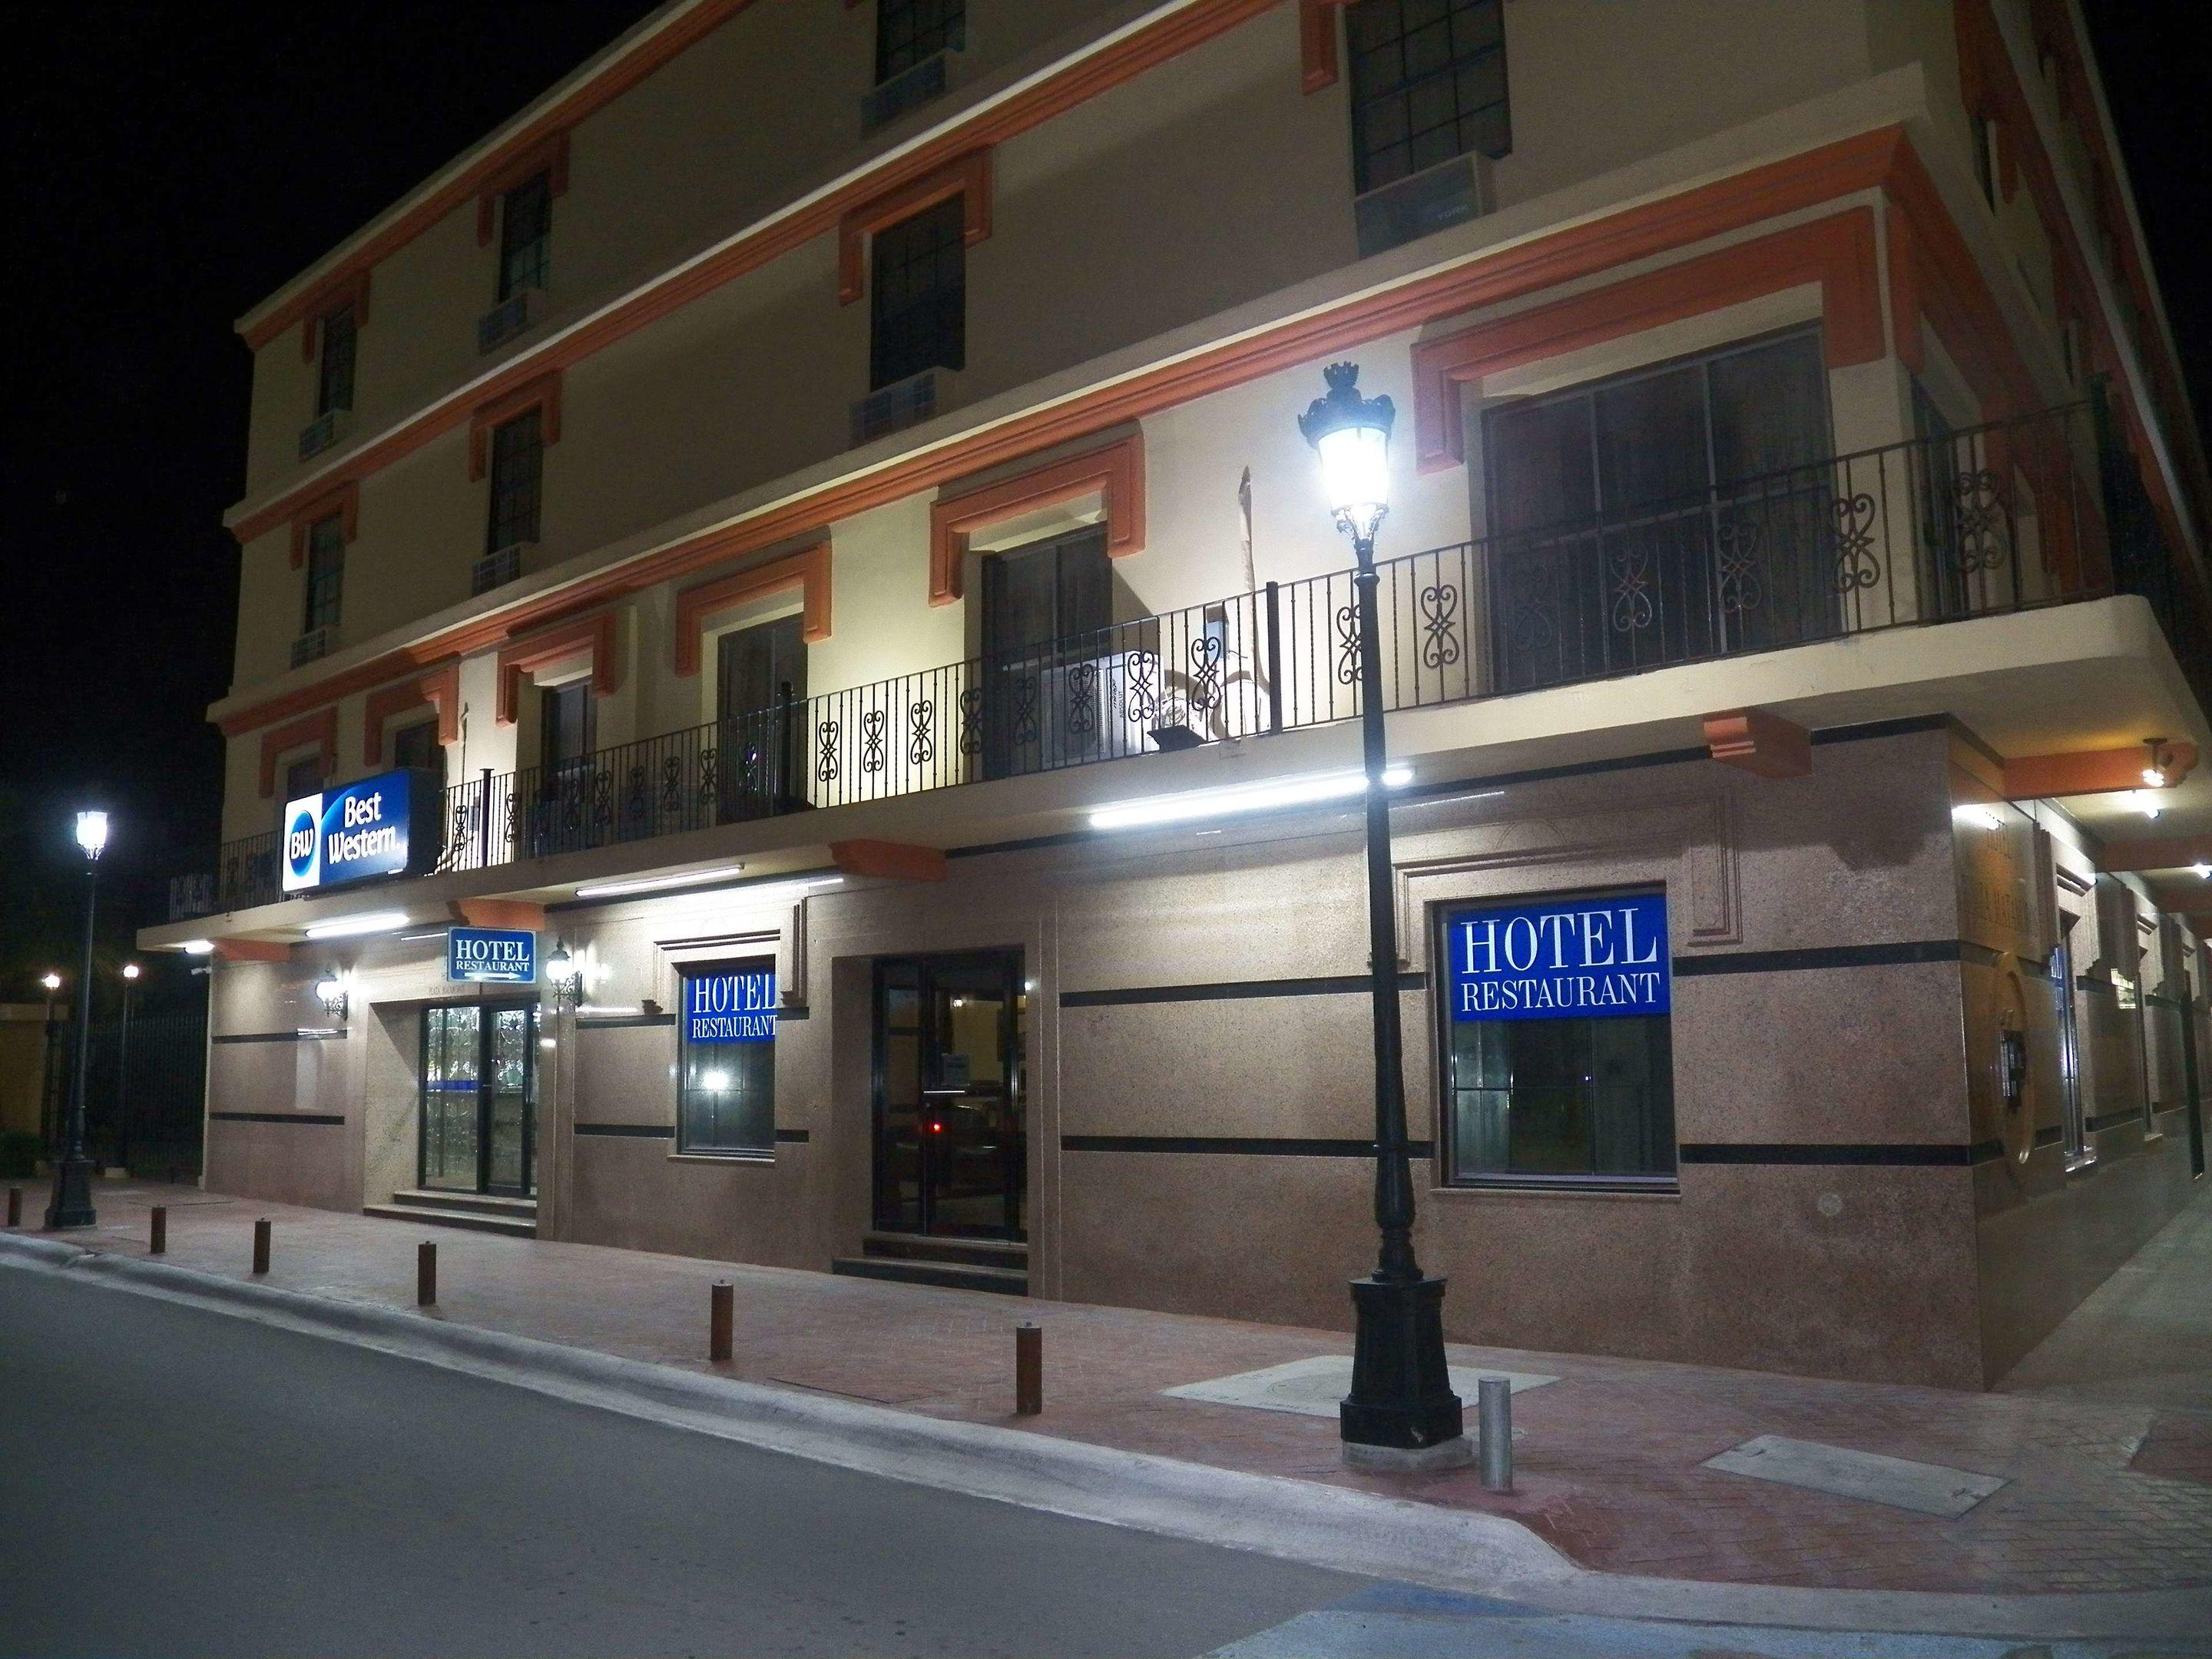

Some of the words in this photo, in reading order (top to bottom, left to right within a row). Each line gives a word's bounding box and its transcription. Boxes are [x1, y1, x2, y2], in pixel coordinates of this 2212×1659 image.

[345, 792, 382, 828] Best
[290, 829, 314, 859] BW
[455, 939, 530, 962] HOTEL
[1461, 908, 1658, 974] HOTEL
[455, 960, 530, 972] RESTAURANT
[693, 973, 777, 1013] HOTEL
[1461, 972, 1661, 1012] RESTAURANT
[692, 1015, 777, 1038] RESTAURANT
